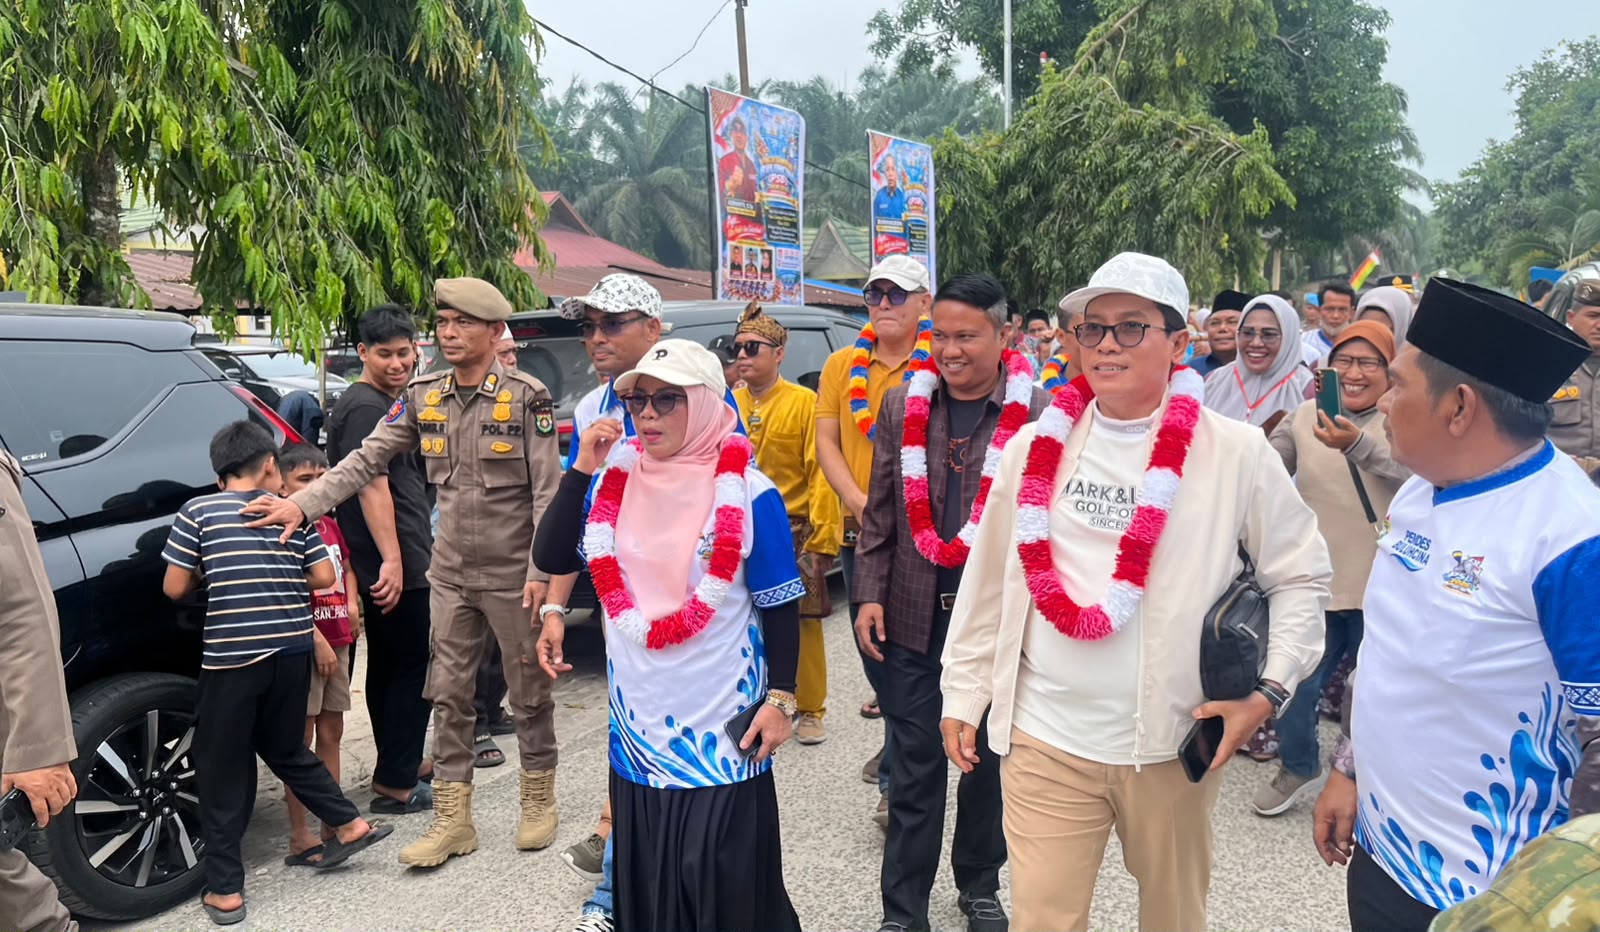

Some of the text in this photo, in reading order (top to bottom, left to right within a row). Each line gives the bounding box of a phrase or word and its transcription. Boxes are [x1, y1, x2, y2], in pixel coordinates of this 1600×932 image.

[653, 349, 668, 361] P
[481, 424, 522, 435] POL PP
[1403, 529, 1432, 552] PENDES
